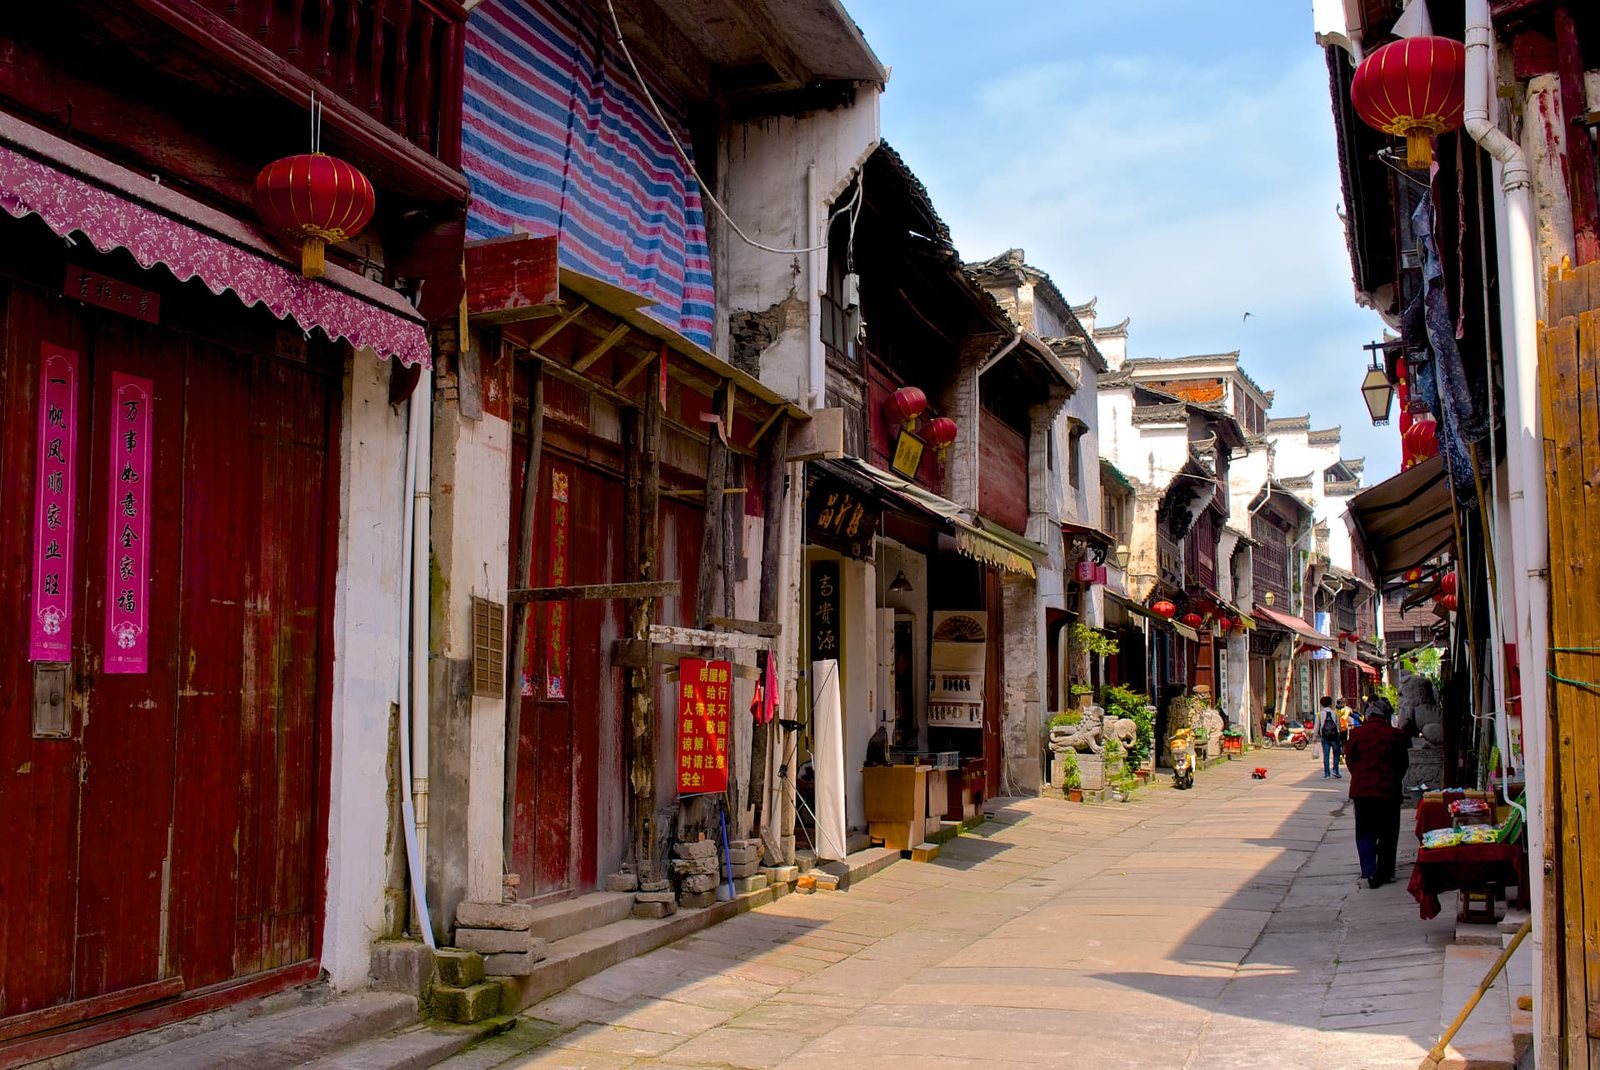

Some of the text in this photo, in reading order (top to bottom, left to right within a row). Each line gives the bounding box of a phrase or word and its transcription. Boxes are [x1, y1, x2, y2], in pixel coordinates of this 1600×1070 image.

[44, 378, 67, 596] 一帆风顺家业旺
[117, 401, 140, 613] 万事如意全家福
[699, 668, 728, 683] 房屋修
[683, 703, 727, 717] 人带来不
[681, 755, 725, 769] 时请注意
